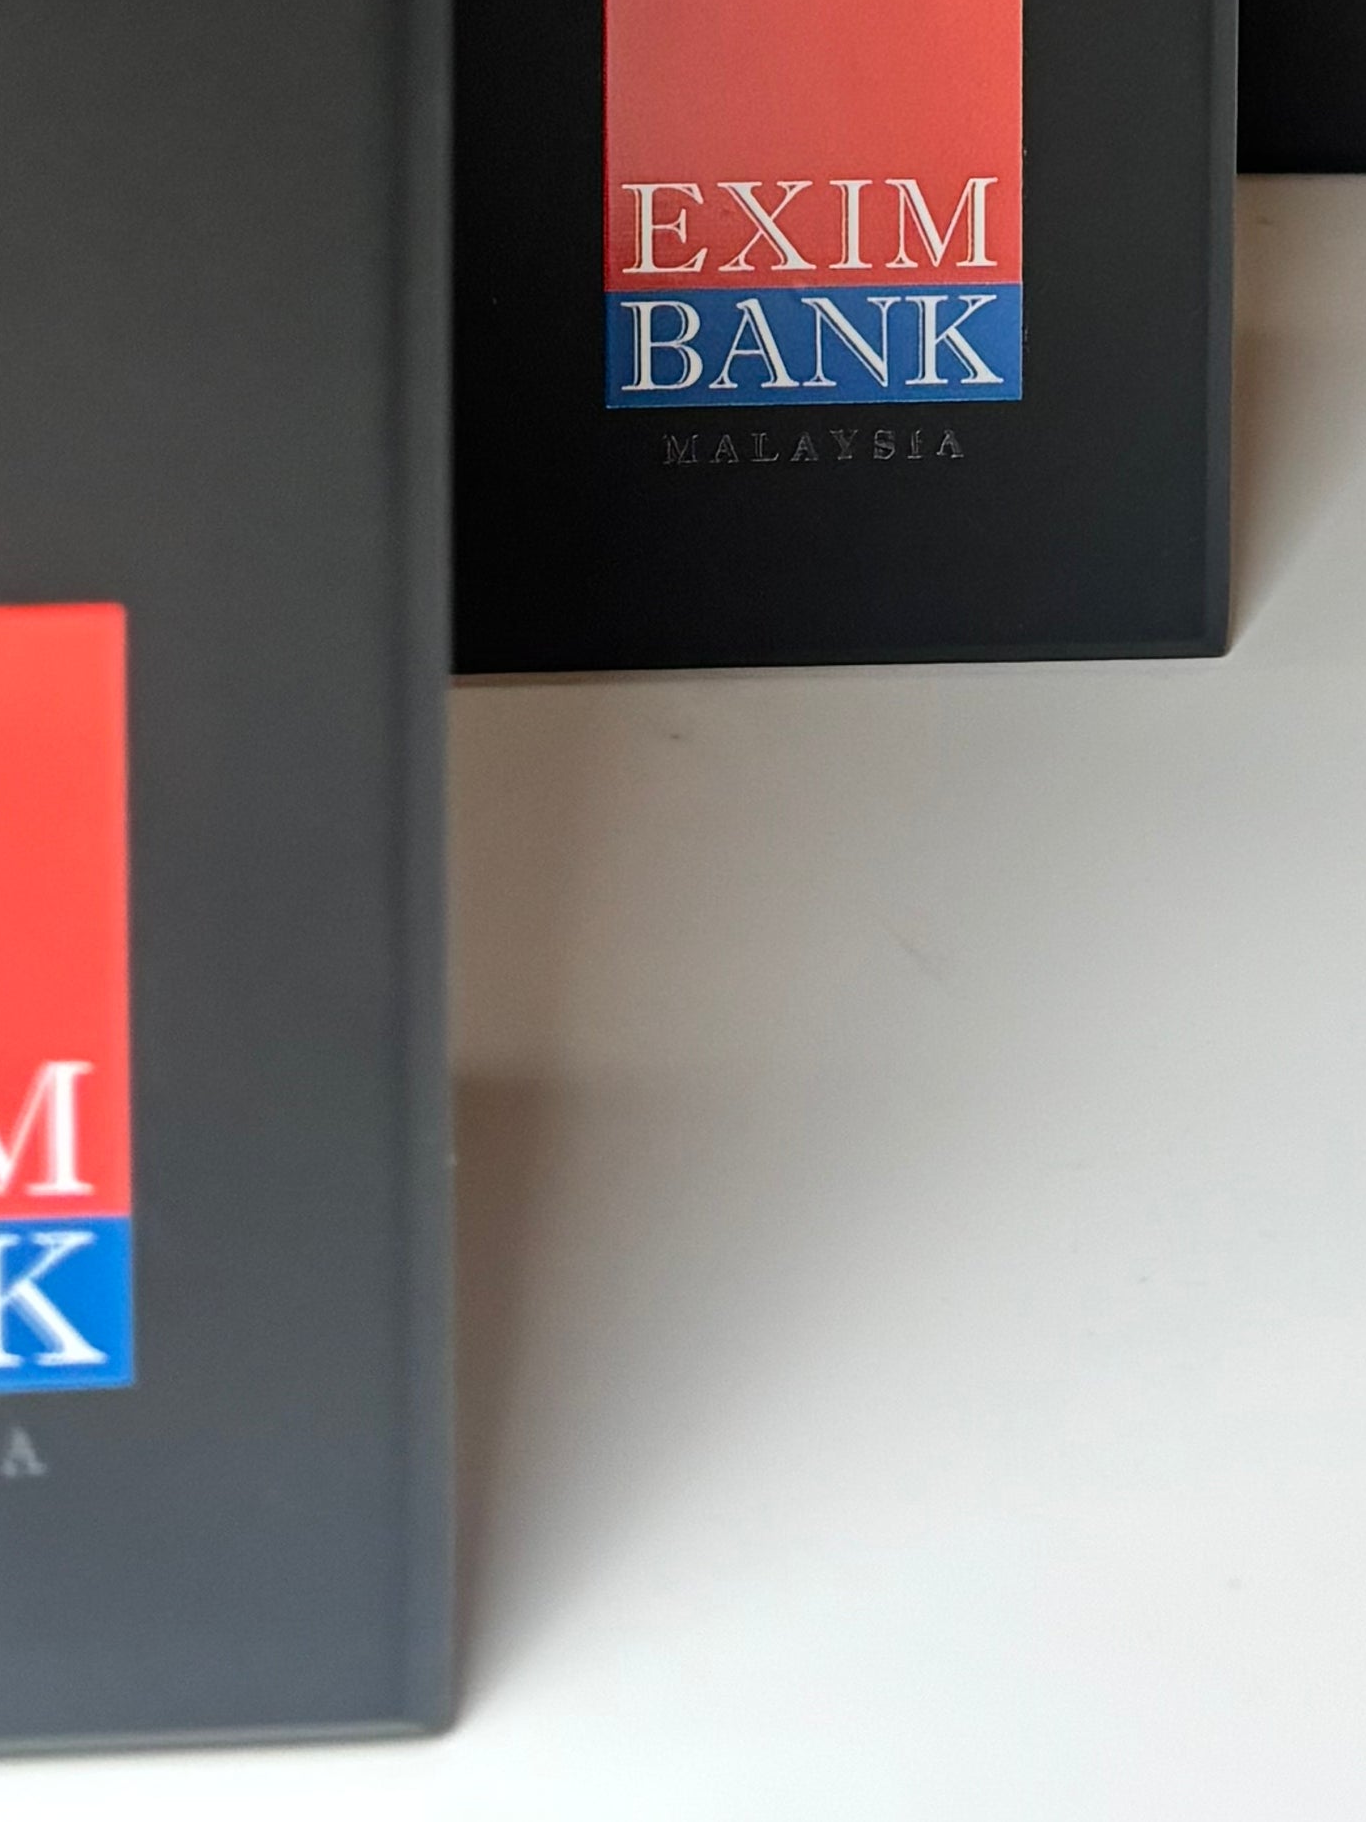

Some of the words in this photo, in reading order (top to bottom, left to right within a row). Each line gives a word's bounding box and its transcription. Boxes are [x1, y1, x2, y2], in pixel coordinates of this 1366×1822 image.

[621, 177, 998, 273] EXIM
[620, 294, 1004, 391] BANK
[662, 429, 964, 464] MALAYSIA
